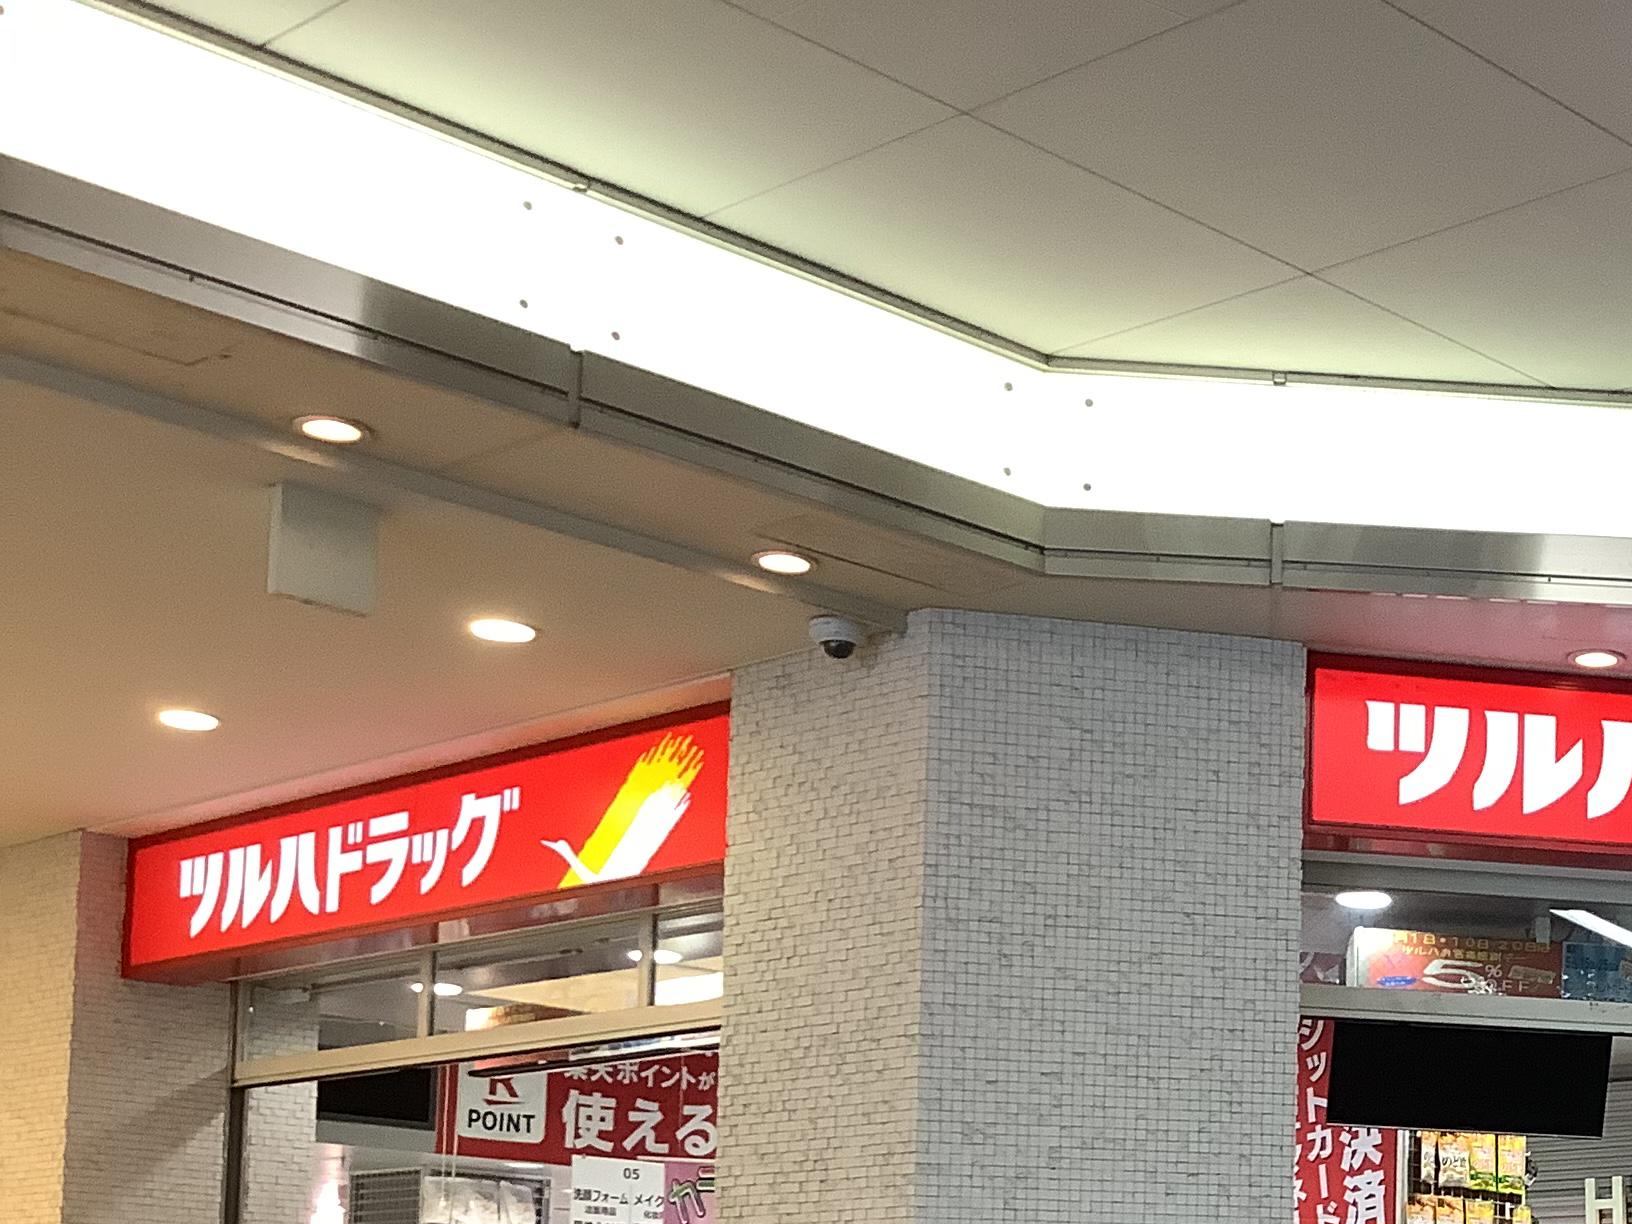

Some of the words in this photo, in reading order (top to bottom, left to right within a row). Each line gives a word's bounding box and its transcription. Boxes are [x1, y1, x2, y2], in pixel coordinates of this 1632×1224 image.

[179, 786, 520, 938] ツルハドラッグ
[467, 1108, 536, 1134] POINT
[561, 1089, 717, 1156] 使える
[623, 1167, 641, 1180] 05
